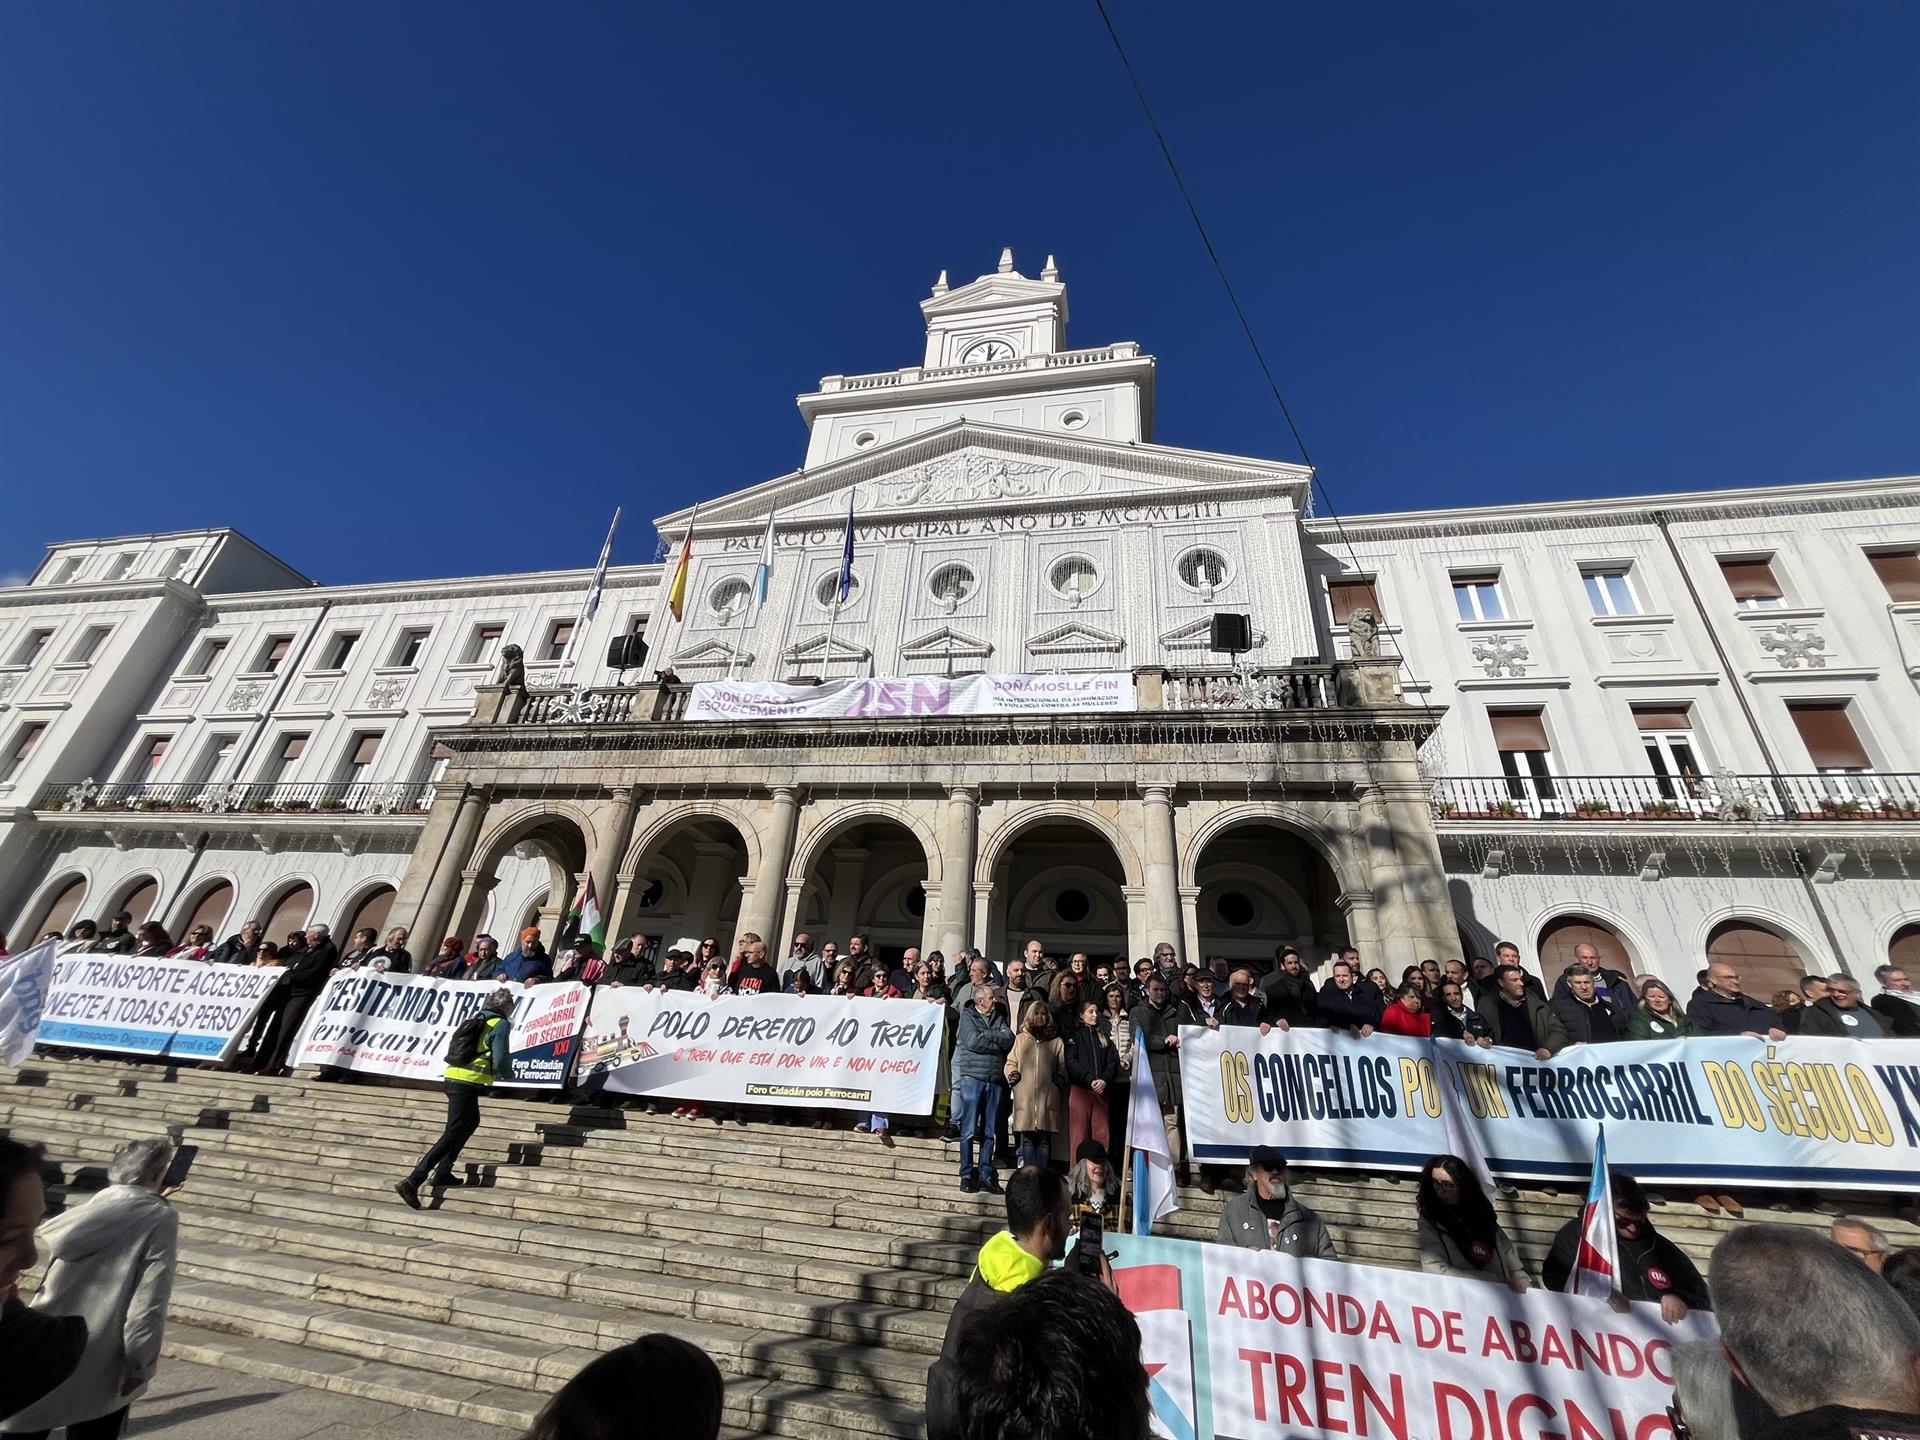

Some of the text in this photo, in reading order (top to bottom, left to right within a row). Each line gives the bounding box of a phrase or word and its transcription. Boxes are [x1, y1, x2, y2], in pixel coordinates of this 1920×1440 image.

[1048, 511, 1086, 529] DE
[993, 679, 1119, 692] POÑÁMOSLLE FIN
[711, 691, 740, 704] NON
[696, 700, 807, 716] ESQUECEMENTO
[79, 961, 189, 994] TRANSPORTE
[740, 977, 763, 989] ALTRI
[566, 990, 581, 1005] UN
[97, 996, 119, 1021] A
[112, 997, 173, 1026] TODAS
[164, 1003, 194, 1028] AS
[447, 991, 492, 1027] TRE
[522, 1006, 576, 1034] FERROCARRIL
[647, 1010, 936, 1050] POLO DEREITO AO TREN
[526, 1032, 539, 1048] DO
[553, 1039, 570, 1057] XXI
[337, 1046, 357, 1057] POR
[512, 1059, 564, 1071] Foro Cidadán
[672, 1047, 685, 1062] O
[687, 1047, 718, 1063] TREN
[719, 1049, 746, 1065] QUE
[776, 1053, 806, 1069] POR
[809, 1055, 830, 1070] VIR
[832, 1056, 843, 1068] E
[846, 1057, 877, 1072] NON
[879, 1059, 921, 1075] CHEGA
[520, 1069, 563, 1081] Ferrocarril
[747, 1084, 871, 1101] Foro Cidadán polo Ferrocarril
[1220, 1050, 1254, 1124] OS
[1253, 1052, 1398, 1123] CONCELLOS
[1457, 1061, 1510, 1119] UN
[1505, 1060, 1713, 1126] FERROCARRIL
[1701, 1059, 1767, 1132] DO
[1751, 1045, 1895, 1148] SÉCULO
[1217, 1276, 1402, 1345] ABONDA
[1411, 1305, 1468, 1354] DE
[1238, 1347, 1411, 1440] TREN
